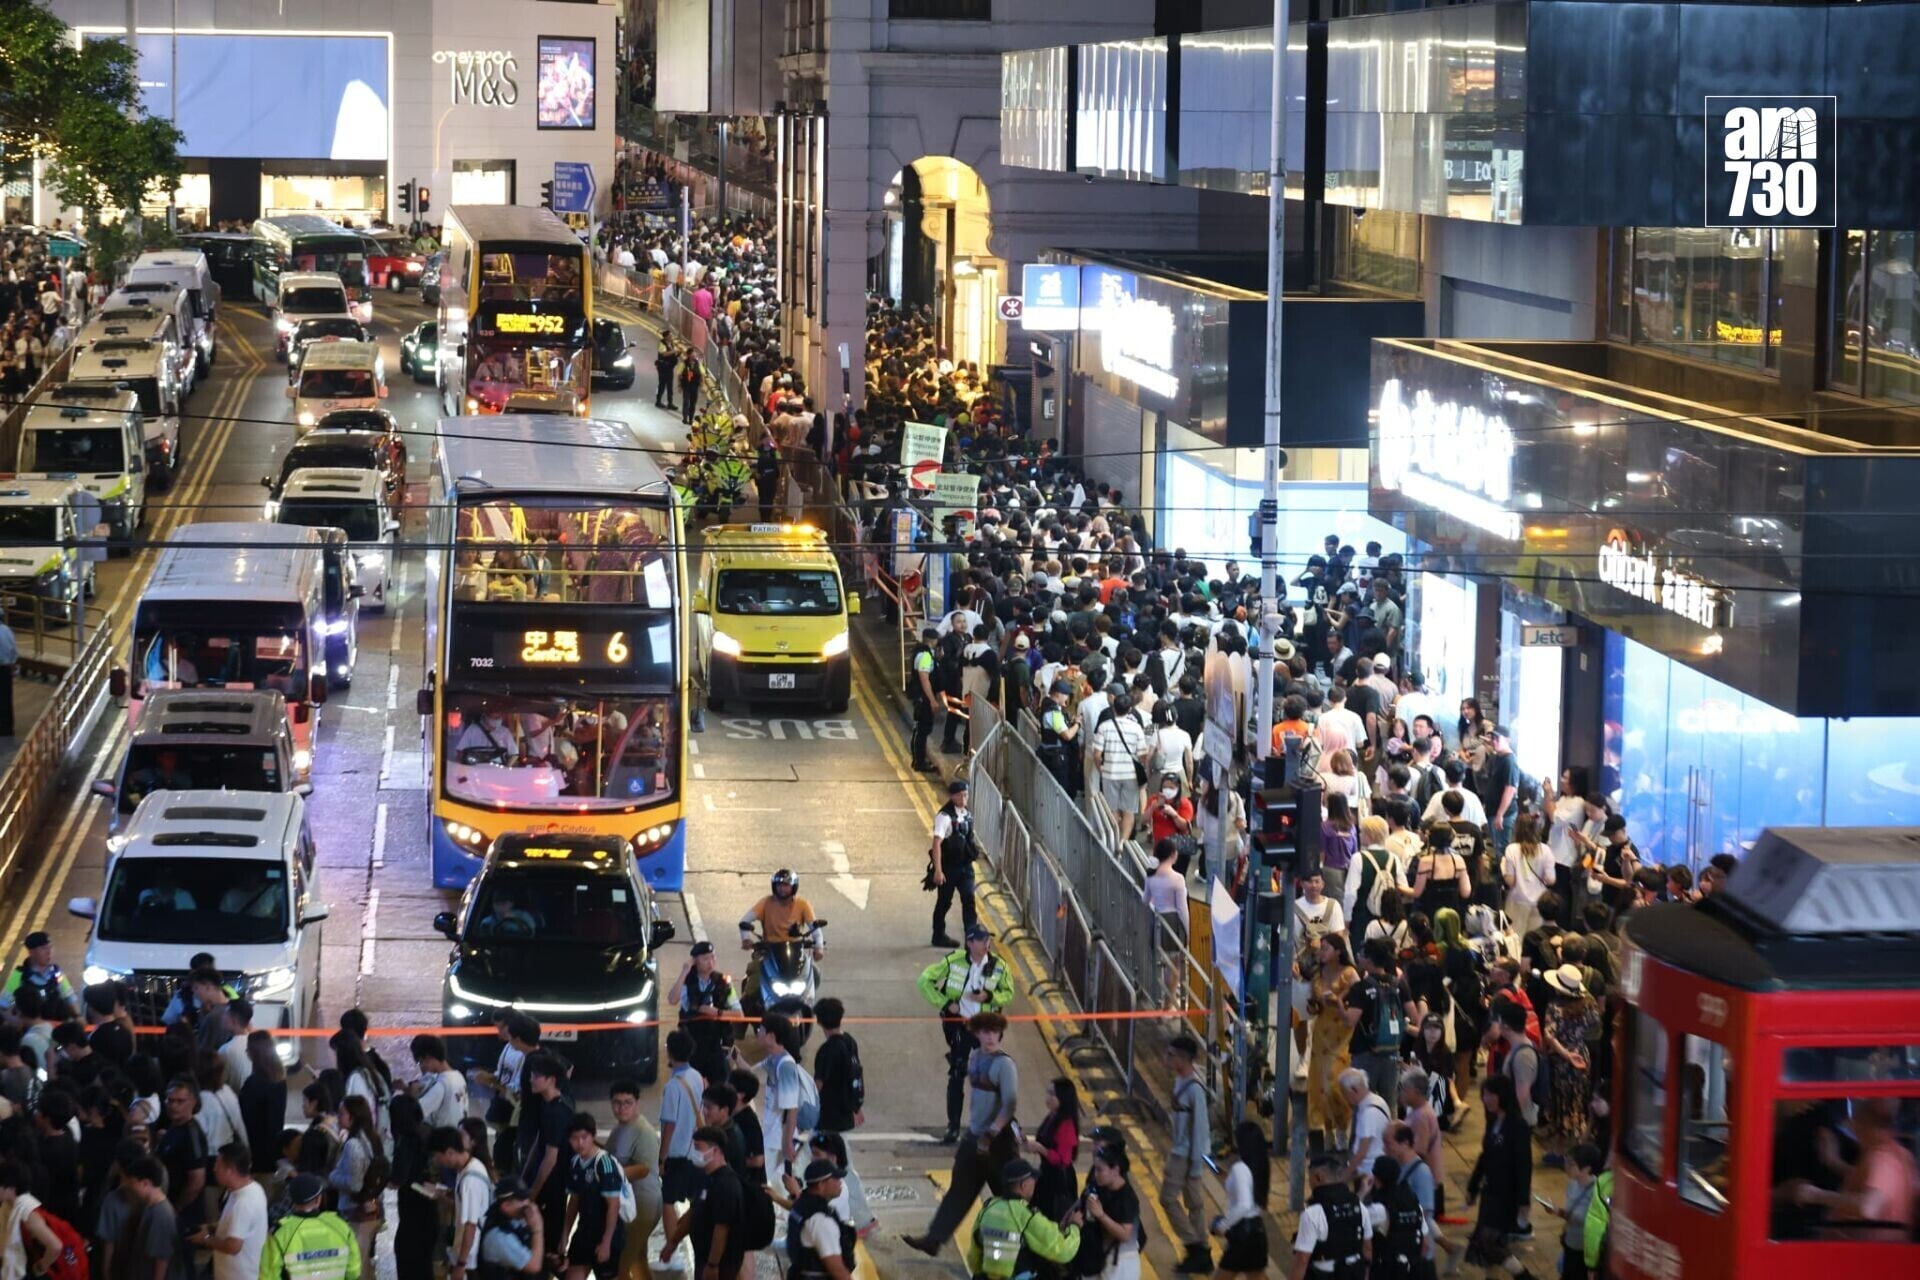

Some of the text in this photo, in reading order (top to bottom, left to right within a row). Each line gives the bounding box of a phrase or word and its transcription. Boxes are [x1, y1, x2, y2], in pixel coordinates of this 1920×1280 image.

[452, 57, 518, 106] M&S
[537, 315, 564, 333] 952
[525, 631, 578, 650] 中環
[607, 632, 628, 663] 6
[470, 658, 494, 667] 7032
[522, 647, 580, 662] Central
[721, 718, 859, 740] BUS
[560, 825, 597, 834] Citybus
